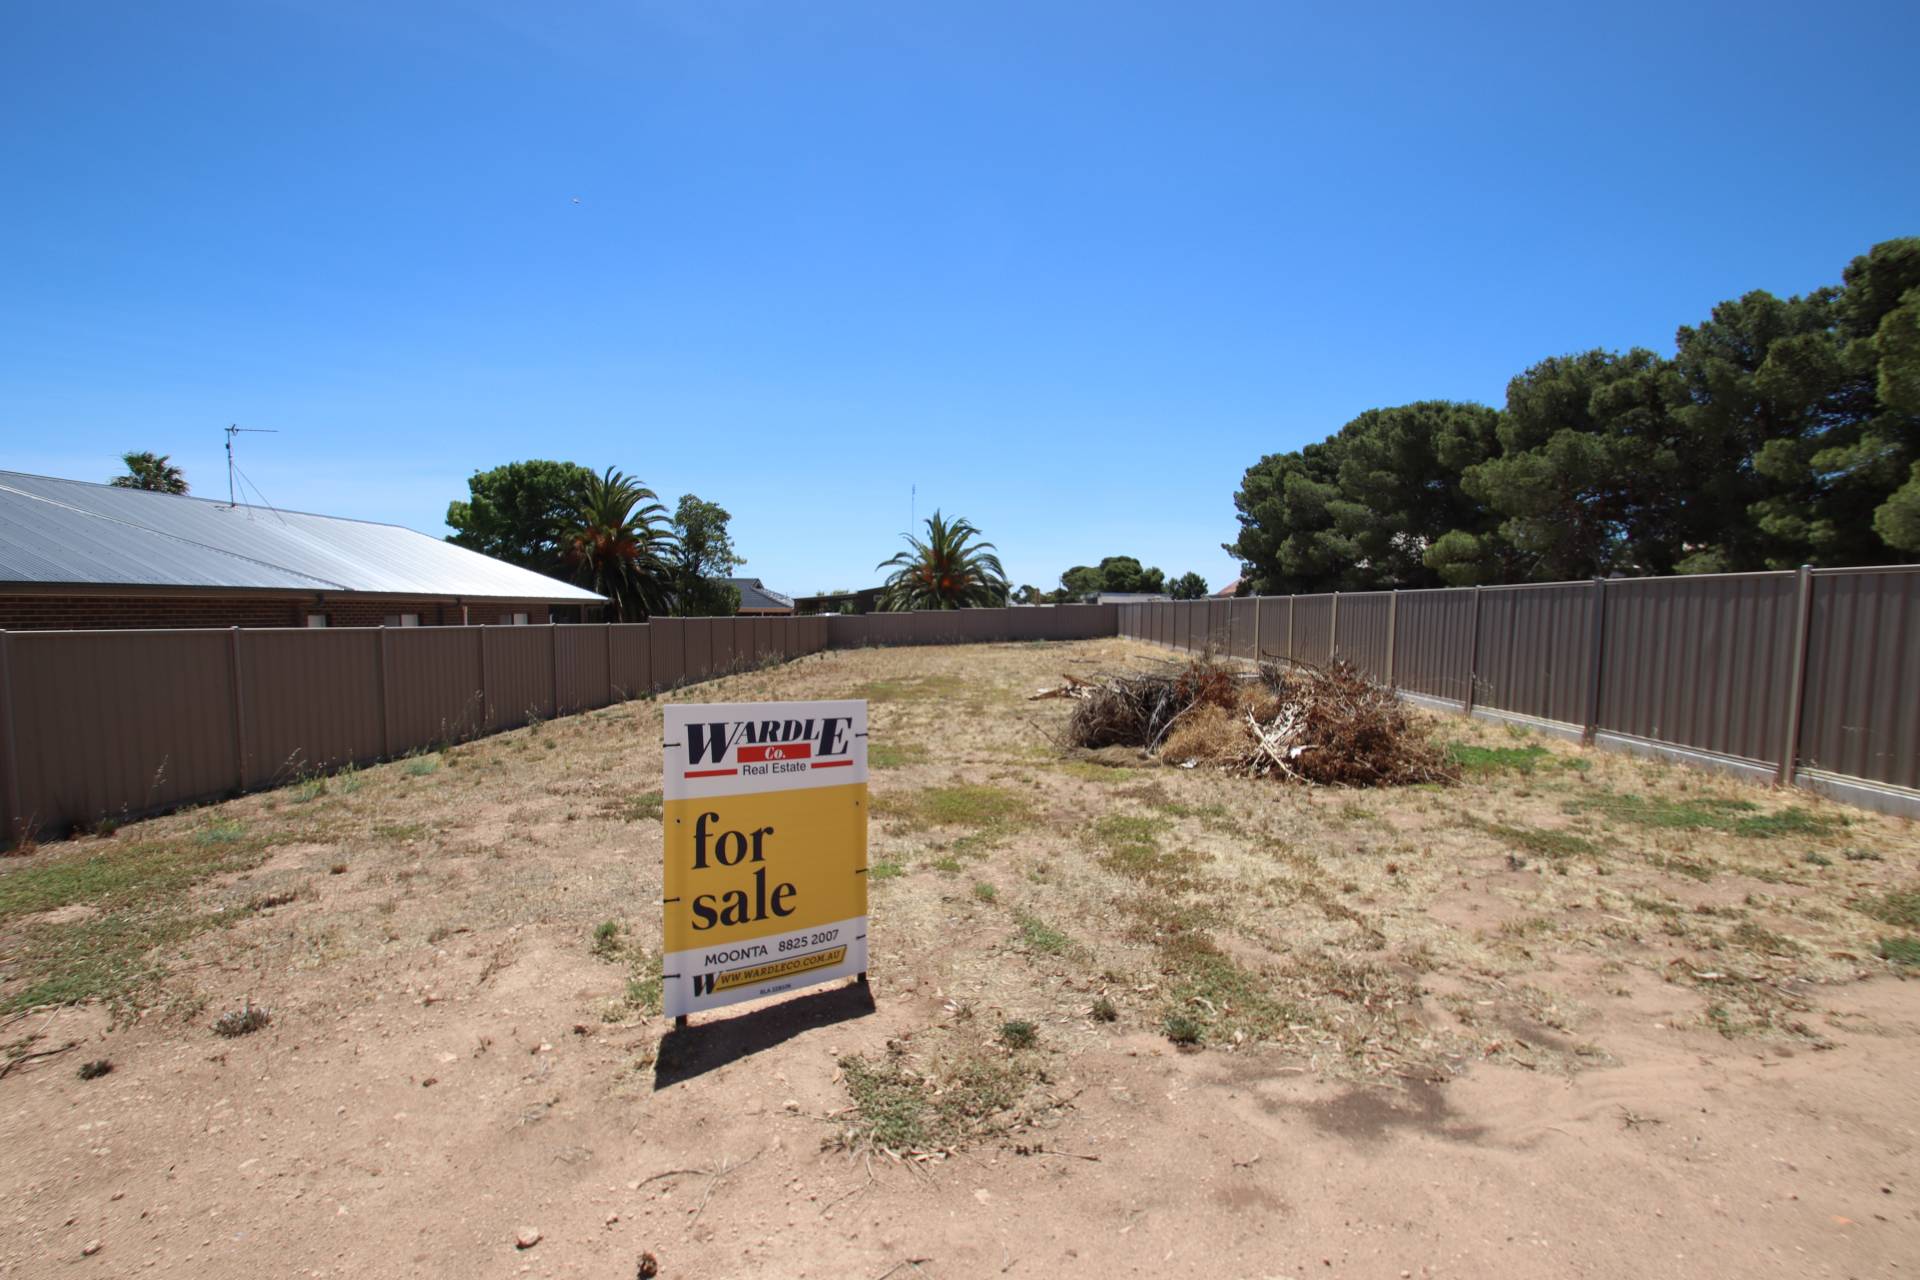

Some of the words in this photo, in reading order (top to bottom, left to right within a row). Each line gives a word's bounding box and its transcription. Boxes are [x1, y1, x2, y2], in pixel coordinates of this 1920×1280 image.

[684, 717, 853, 765] WARDLE
[764, 746, 786, 760] Co.
[742, 763, 769, 776] Real
[772, 762, 807, 774] Estate
[691, 811, 774, 870] for
[691, 866, 797, 931] sale
[704, 945, 768, 967] MOONTA
[778, 936, 808, 952] 8825
[811, 929, 839, 945] 2007
